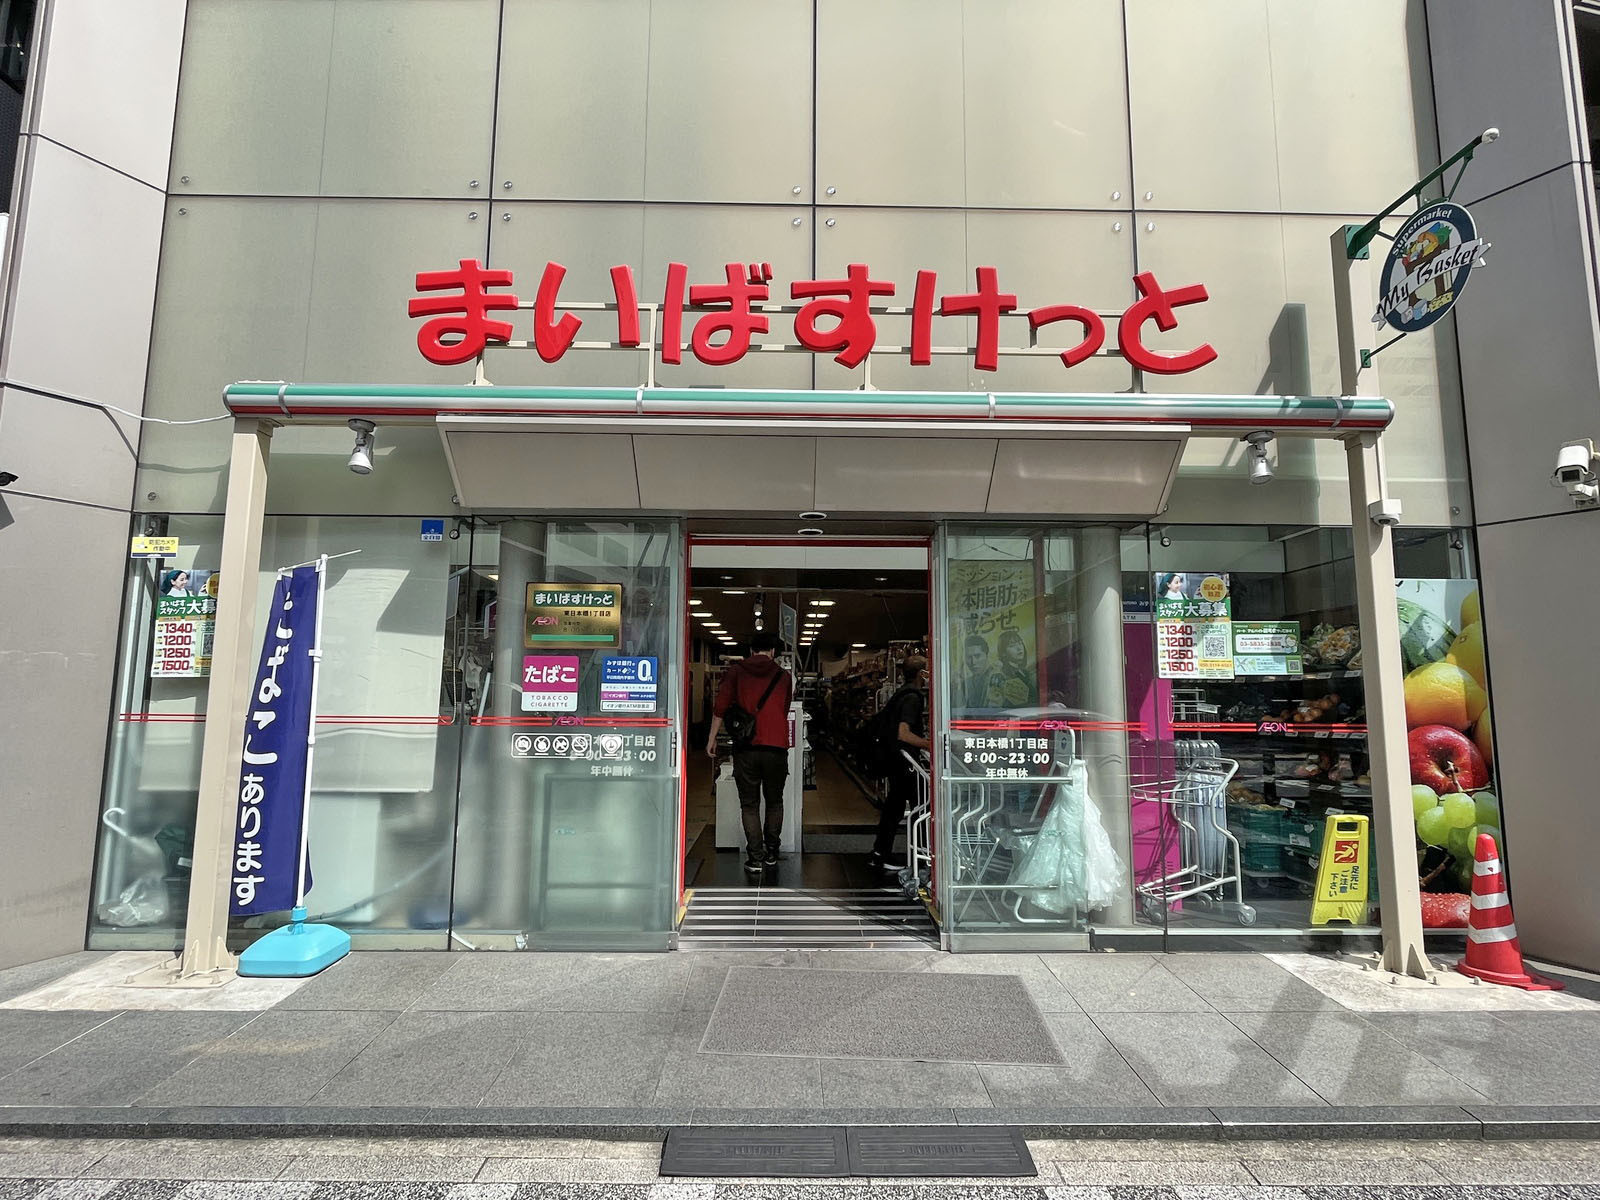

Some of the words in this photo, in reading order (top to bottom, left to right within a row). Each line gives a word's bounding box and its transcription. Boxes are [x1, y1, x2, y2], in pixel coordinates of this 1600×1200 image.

[408, 258, 1218, 375] まいばすけっと
[534, 592, 613, 605] まいばすけっと
[1184, 602, 1228, 617] 大募集
[524, 664, 577, 684] たばこ
[964, 738, 1049, 750] 東日本橋1丁目店
[985, 768, 1029, 779] 年中無休
